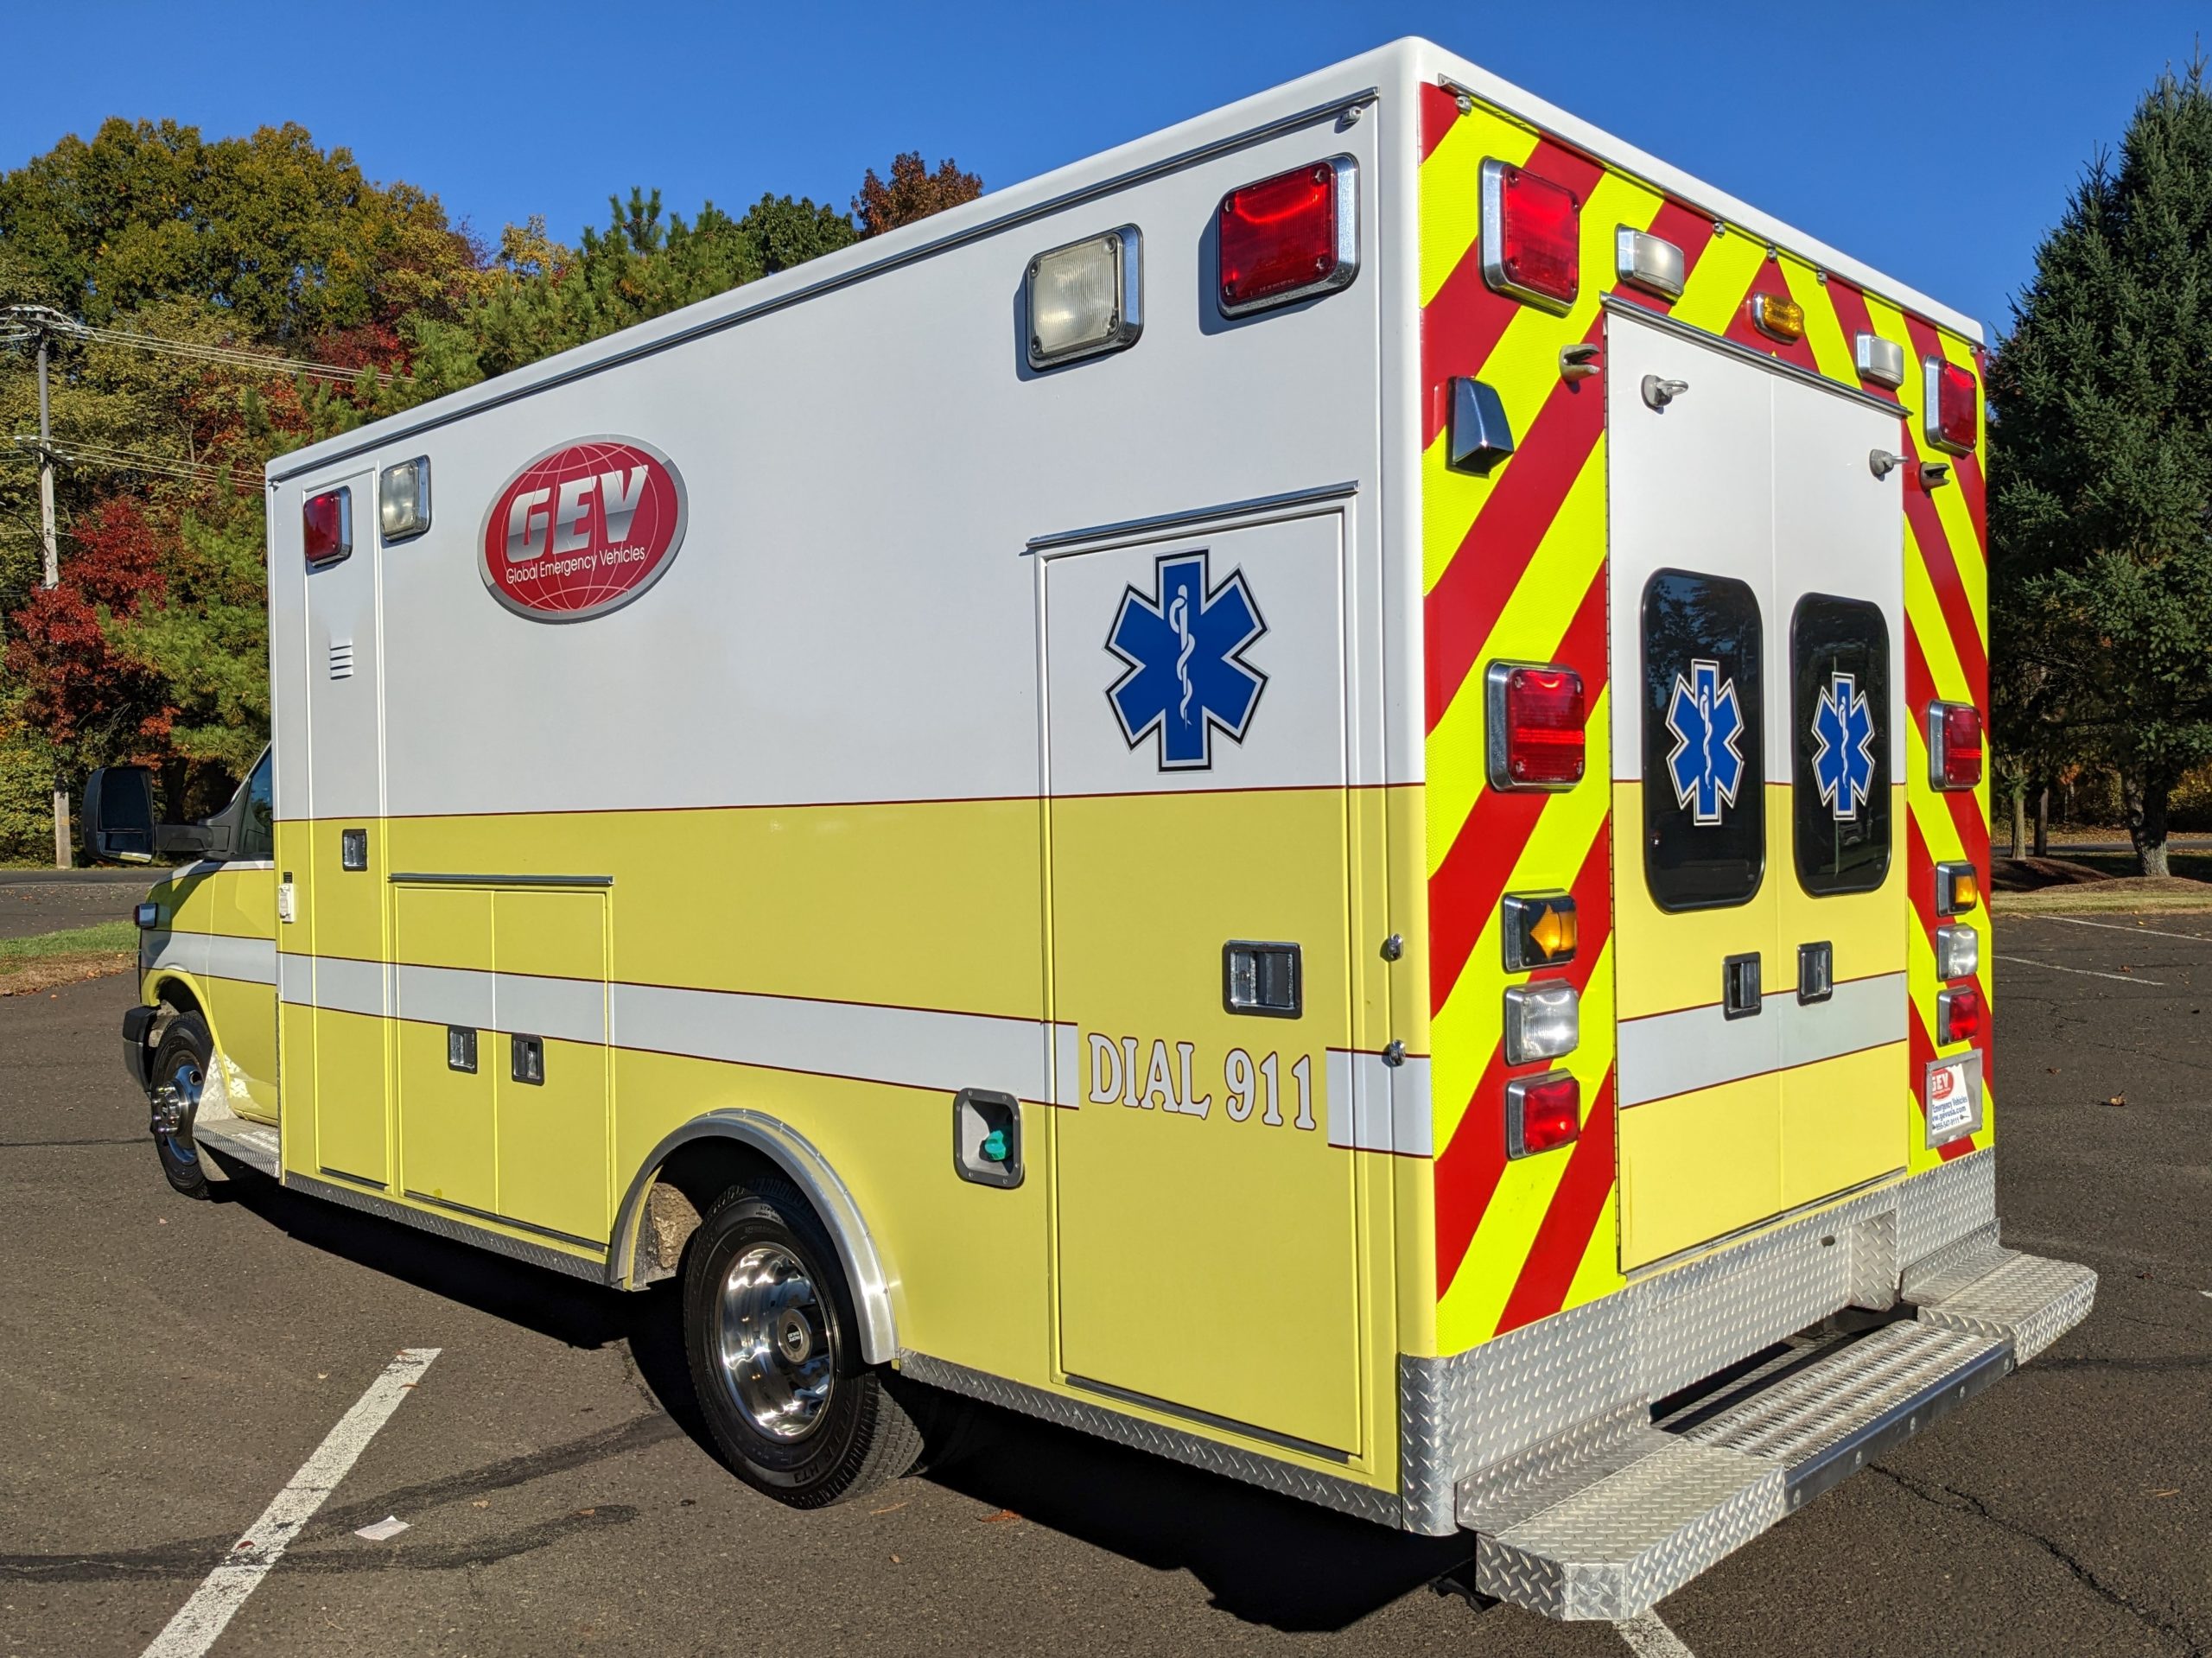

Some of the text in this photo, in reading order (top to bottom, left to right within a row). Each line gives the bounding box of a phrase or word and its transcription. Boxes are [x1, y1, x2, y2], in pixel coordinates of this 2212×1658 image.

[506, 465, 648, 563] GEV
[506, 546, 645, 584] Global Emergency Vehicles
[1088, 1032, 1317, 1131] DIAL 911
